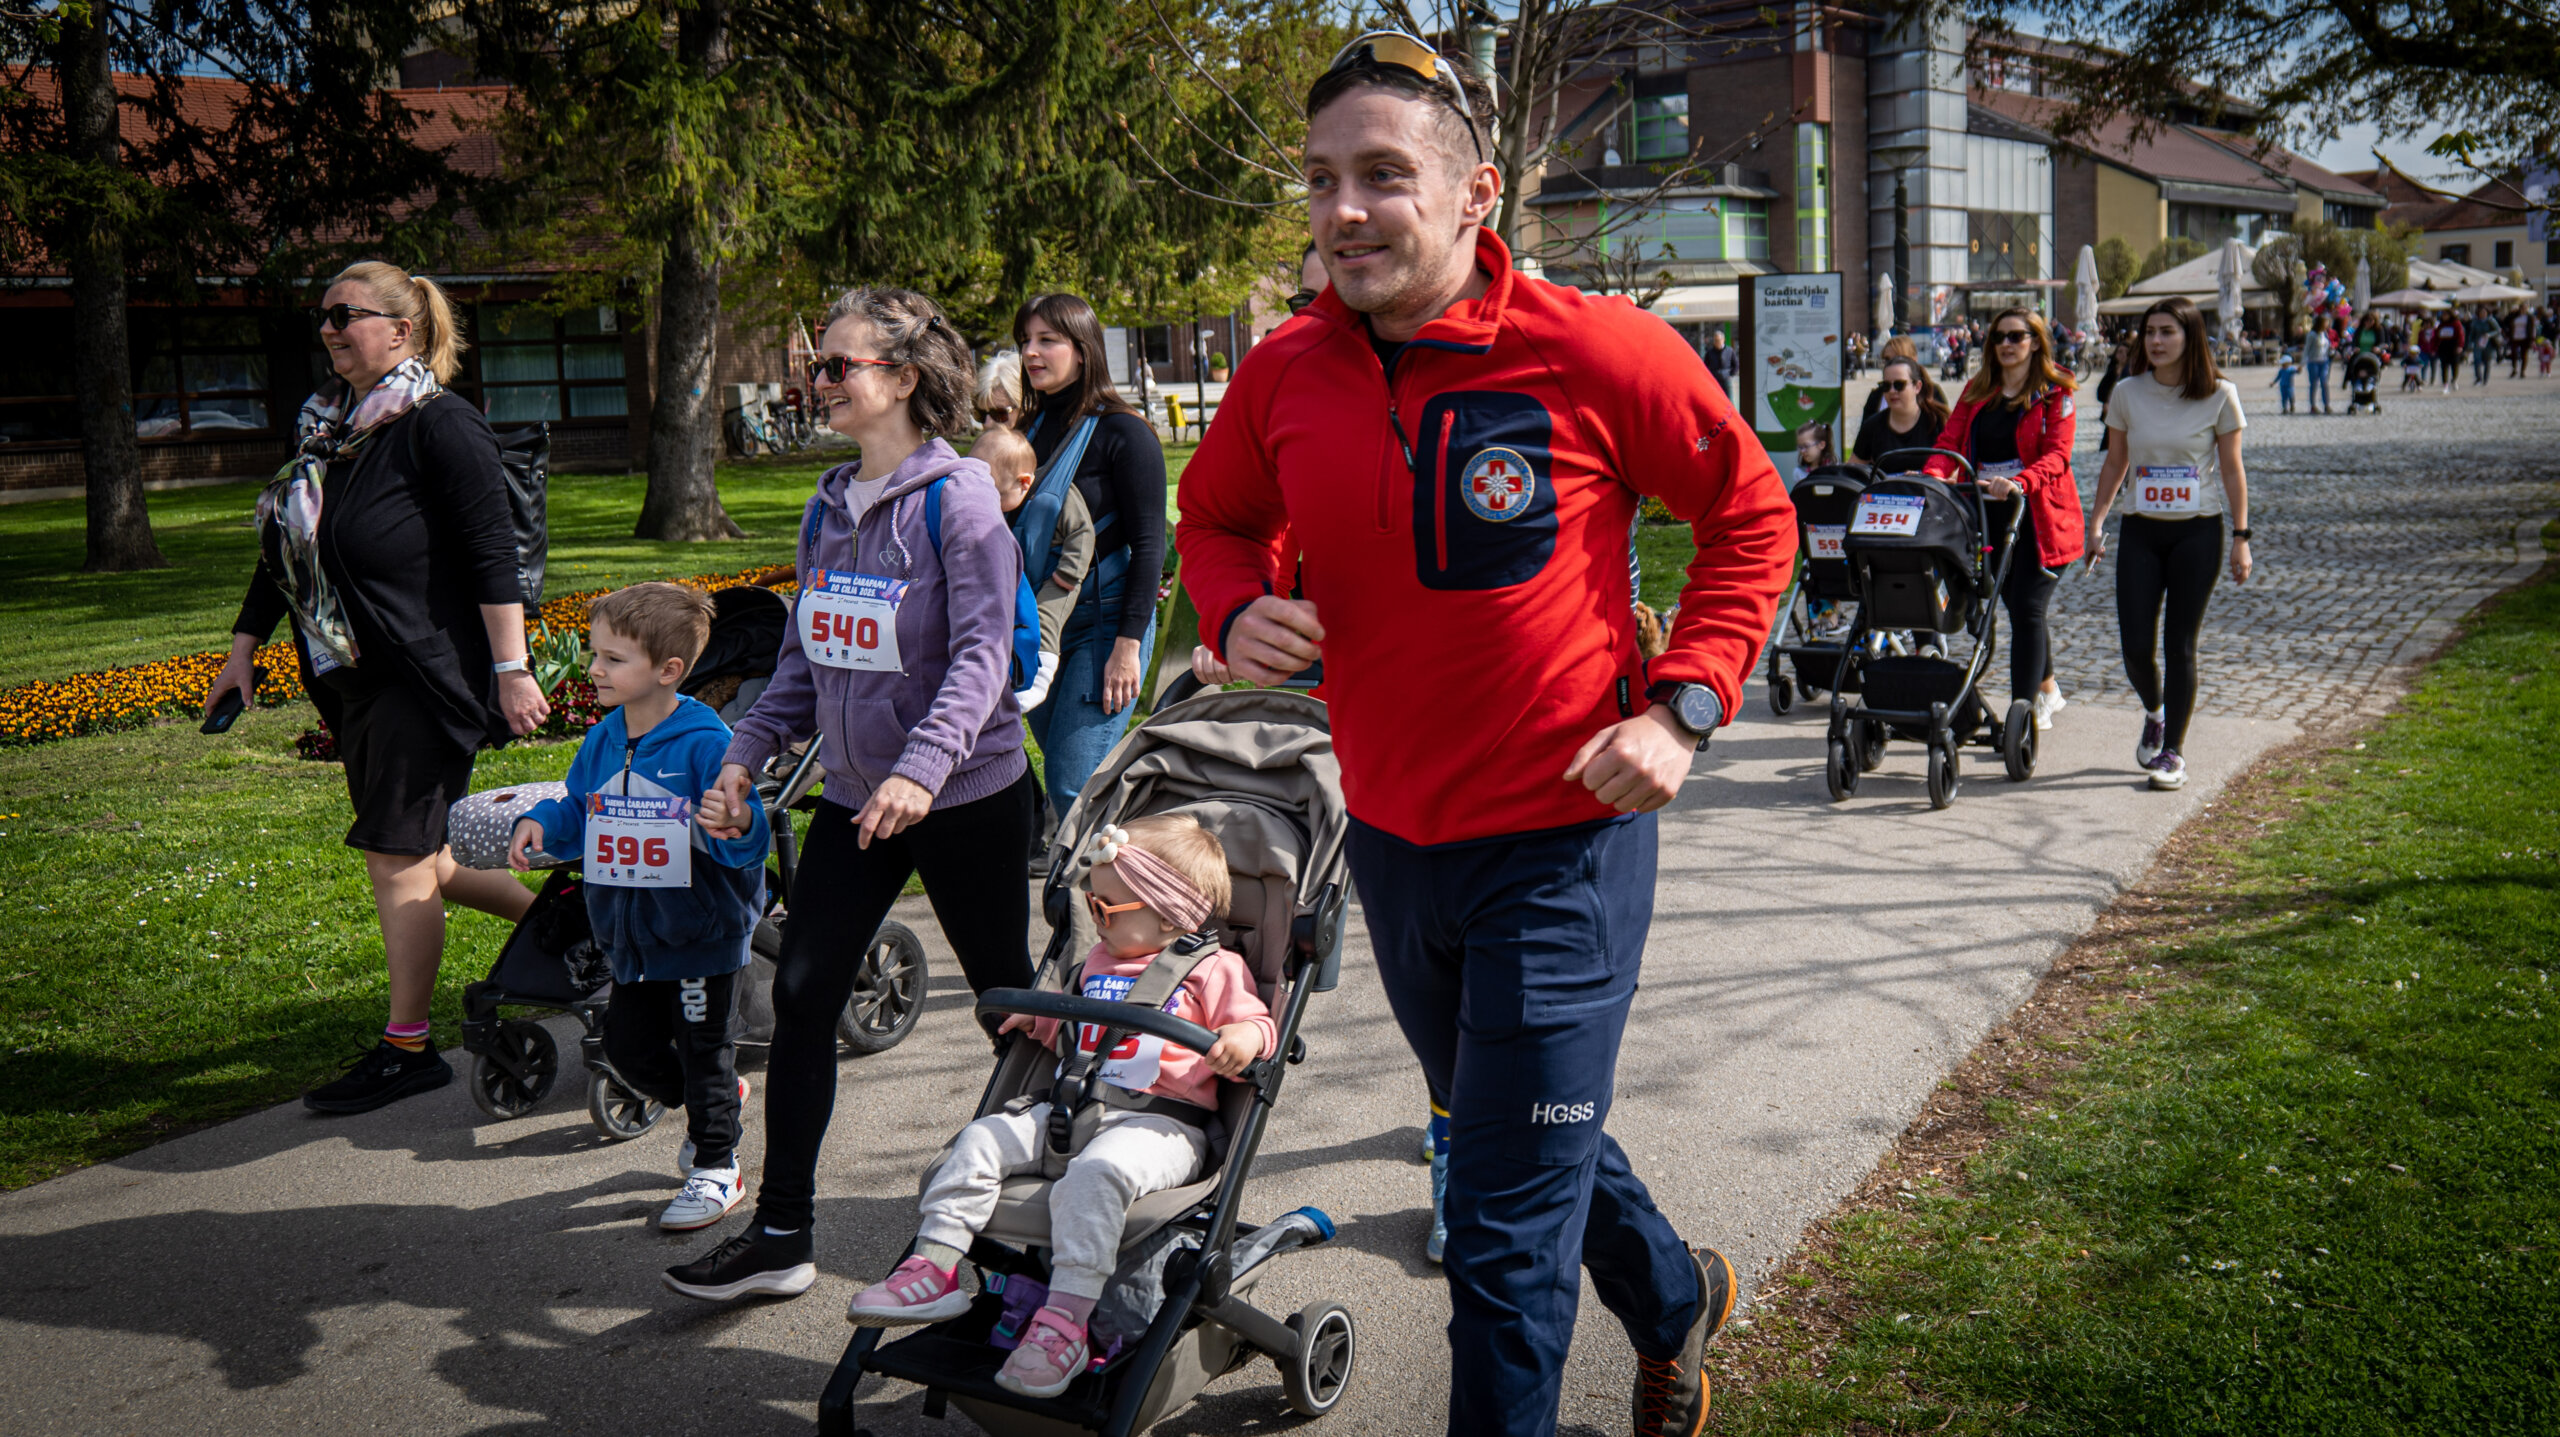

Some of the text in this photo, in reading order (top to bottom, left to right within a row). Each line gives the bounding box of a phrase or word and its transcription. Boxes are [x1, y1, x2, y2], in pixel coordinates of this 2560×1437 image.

[1764, 285, 1829, 297] Graditeljska
[1764, 297, 1803, 307] baština
[2145, 487, 2191, 502] 084
[1865, 512, 1910, 526] 364
[1817, 539, 1845, 551] 59
[853, 576, 887, 589] ČARAPAMA
[830, 584, 840, 592] DO
[841, 585, 858, 595] CILJA
[811, 611, 879, 650] 540
[627, 798, 667, 809] ČARAPAMA
[608, 807, 616, 815] DO
[617, 808, 635, 817] CILJA
[597, 834, 669, 867] 596
[1531, 1101, 1595, 1125] HGSS
